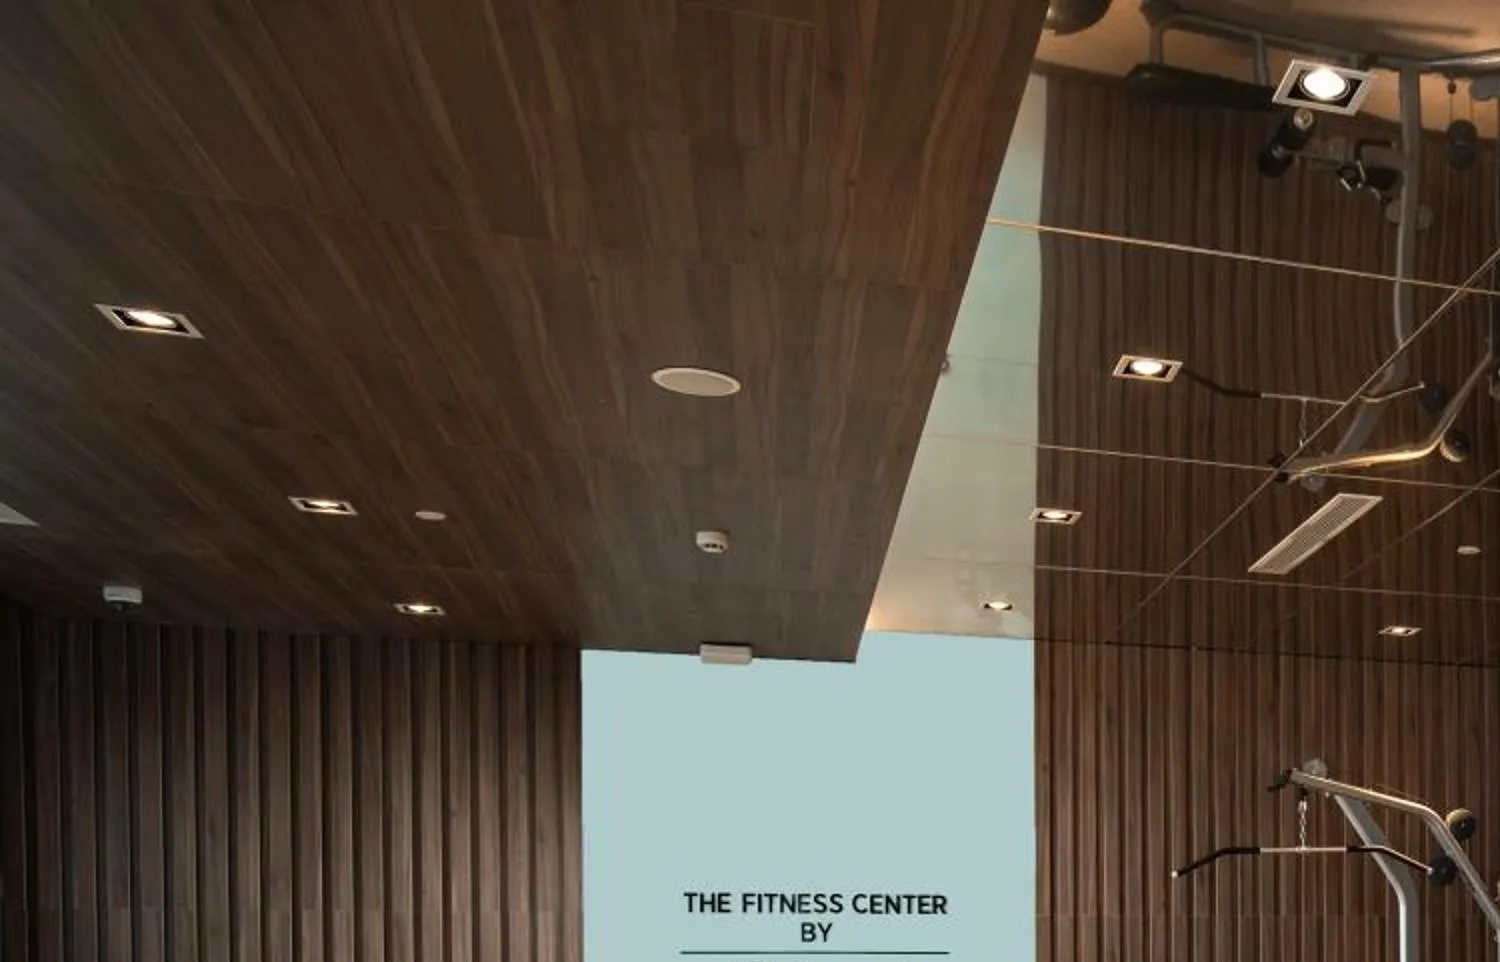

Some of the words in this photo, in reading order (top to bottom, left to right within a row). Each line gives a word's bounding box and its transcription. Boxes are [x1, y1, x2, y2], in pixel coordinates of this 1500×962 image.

[683, 892, 733, 914] THE
[741, 892, 844, 915] FITNESS
[851, 893, 949, 915] CENTER
[800, 922, 833, 943] BY
